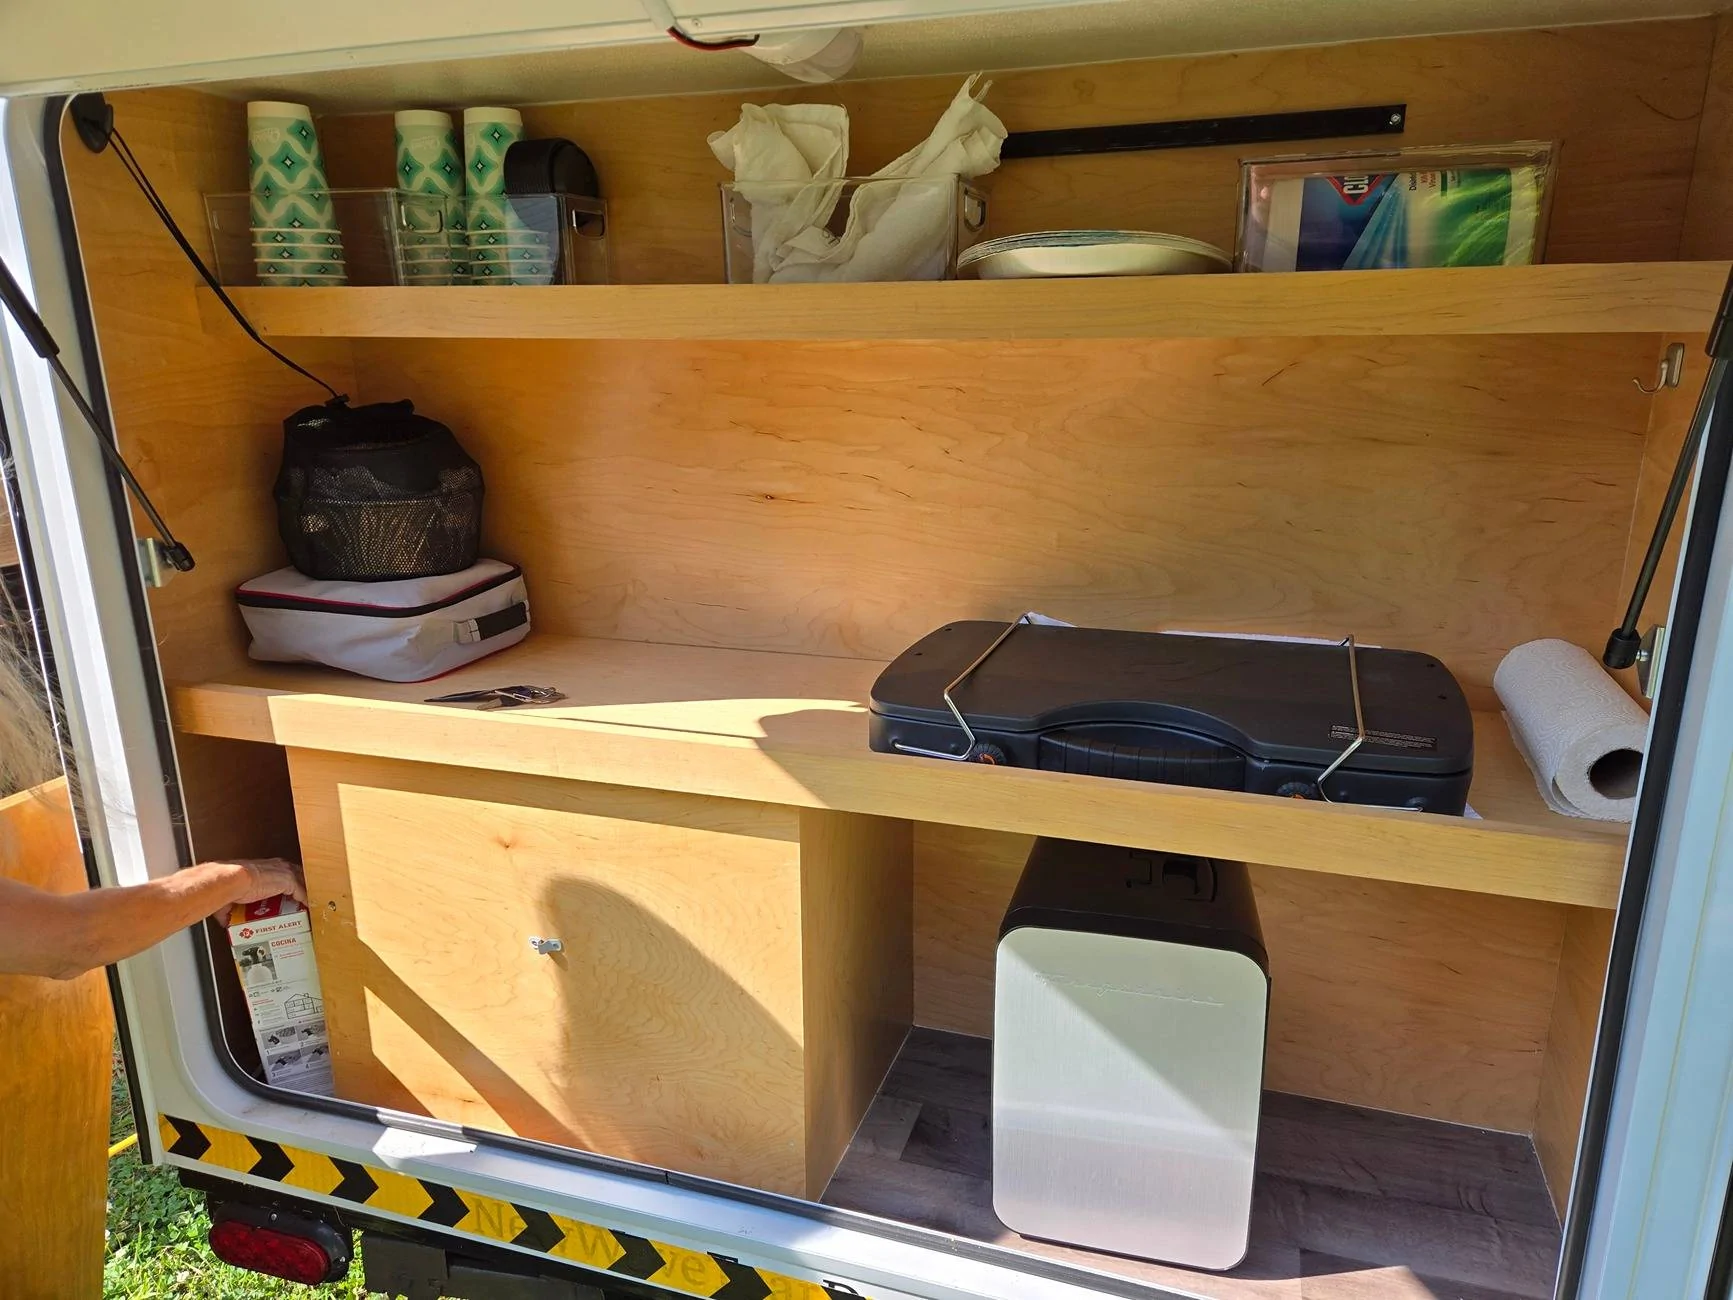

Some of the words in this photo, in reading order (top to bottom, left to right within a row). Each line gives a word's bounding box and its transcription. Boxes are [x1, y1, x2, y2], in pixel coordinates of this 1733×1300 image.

[255, 925, 276, 934] FIRST
[278, 920, 302, 930] ALERT
[271, 938, 297, 948] COCINA
